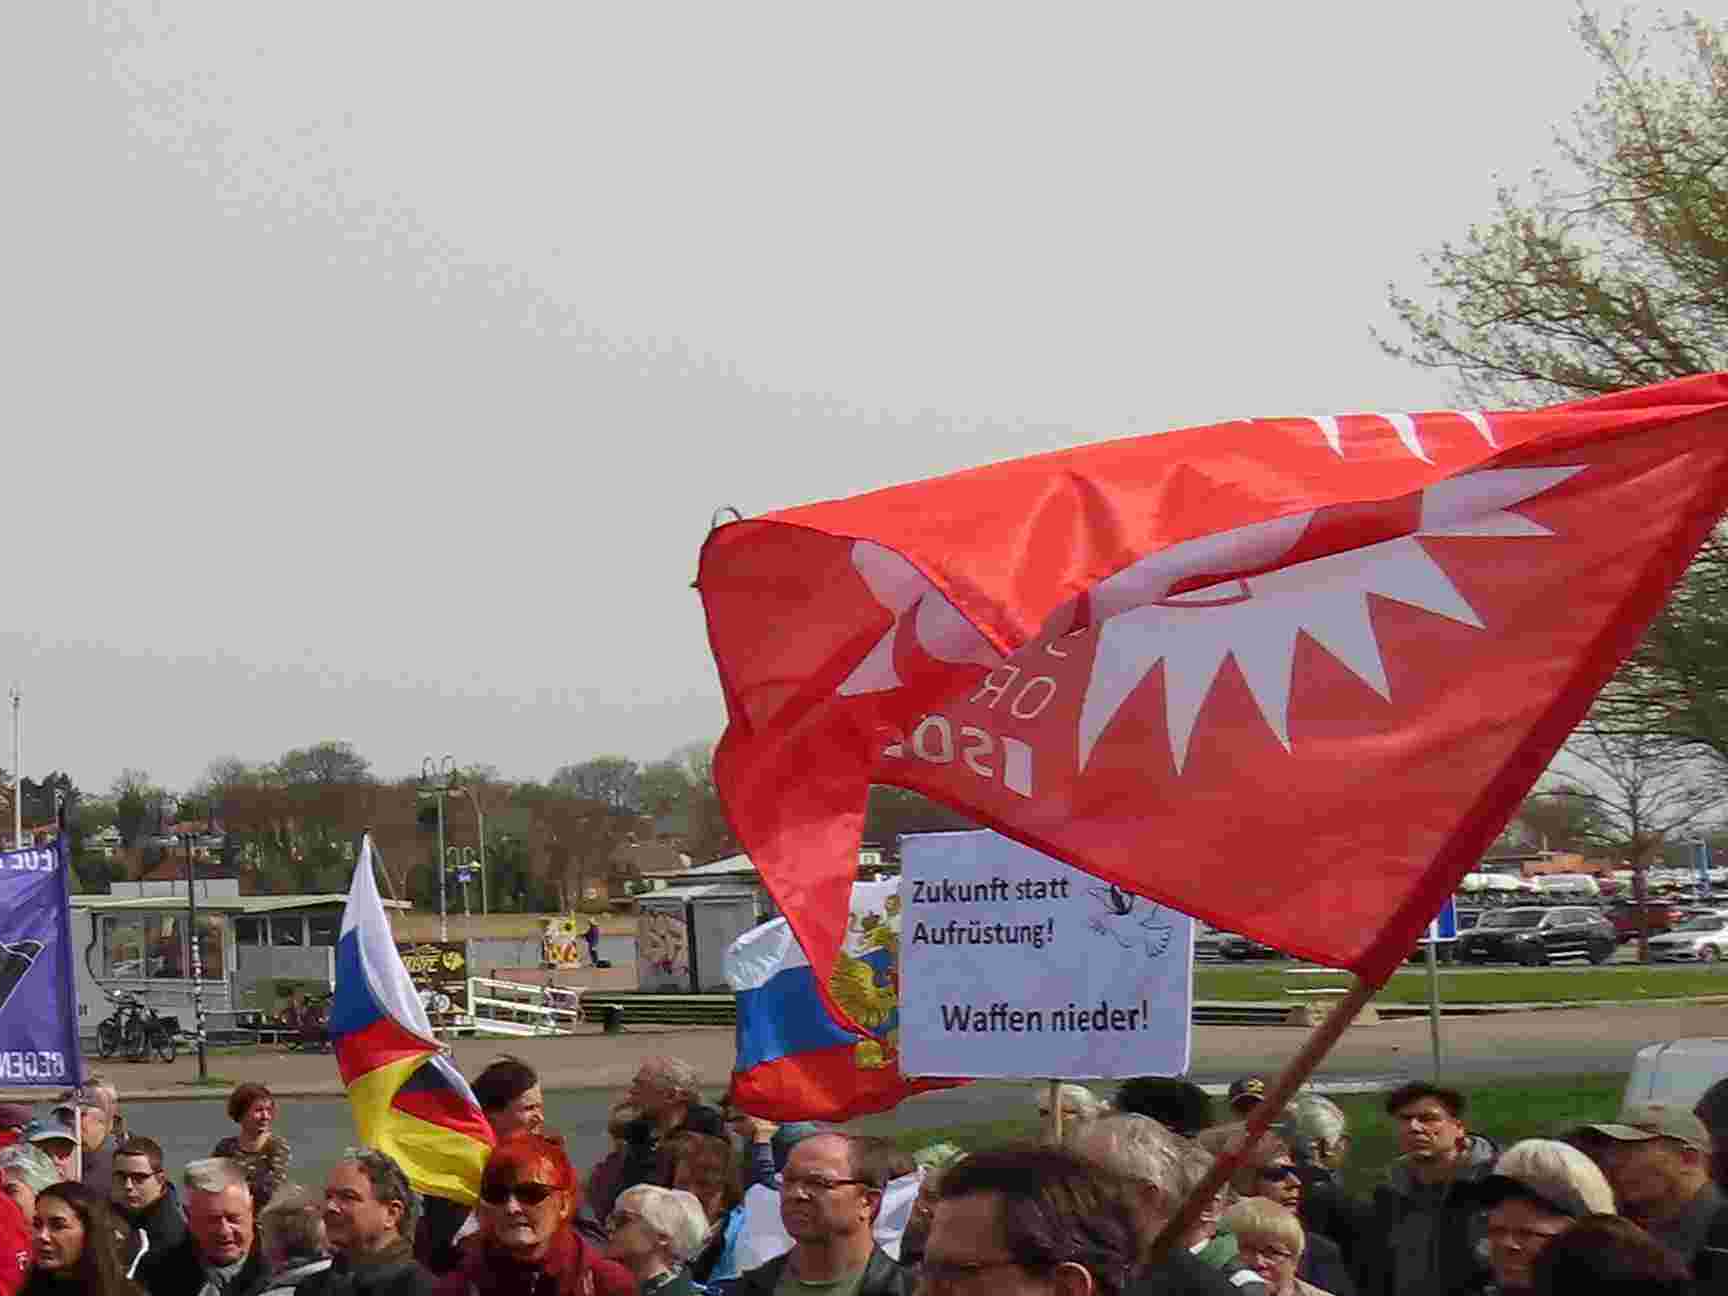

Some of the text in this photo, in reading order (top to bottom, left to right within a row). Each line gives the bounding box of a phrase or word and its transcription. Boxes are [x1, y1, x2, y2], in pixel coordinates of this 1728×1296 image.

[911, 877, 1071, 904] Zukunft statt
[911, 917, 1056, 950] Aufrüstung!
[940, 999, 1150, 1033] Waffen nieder!
